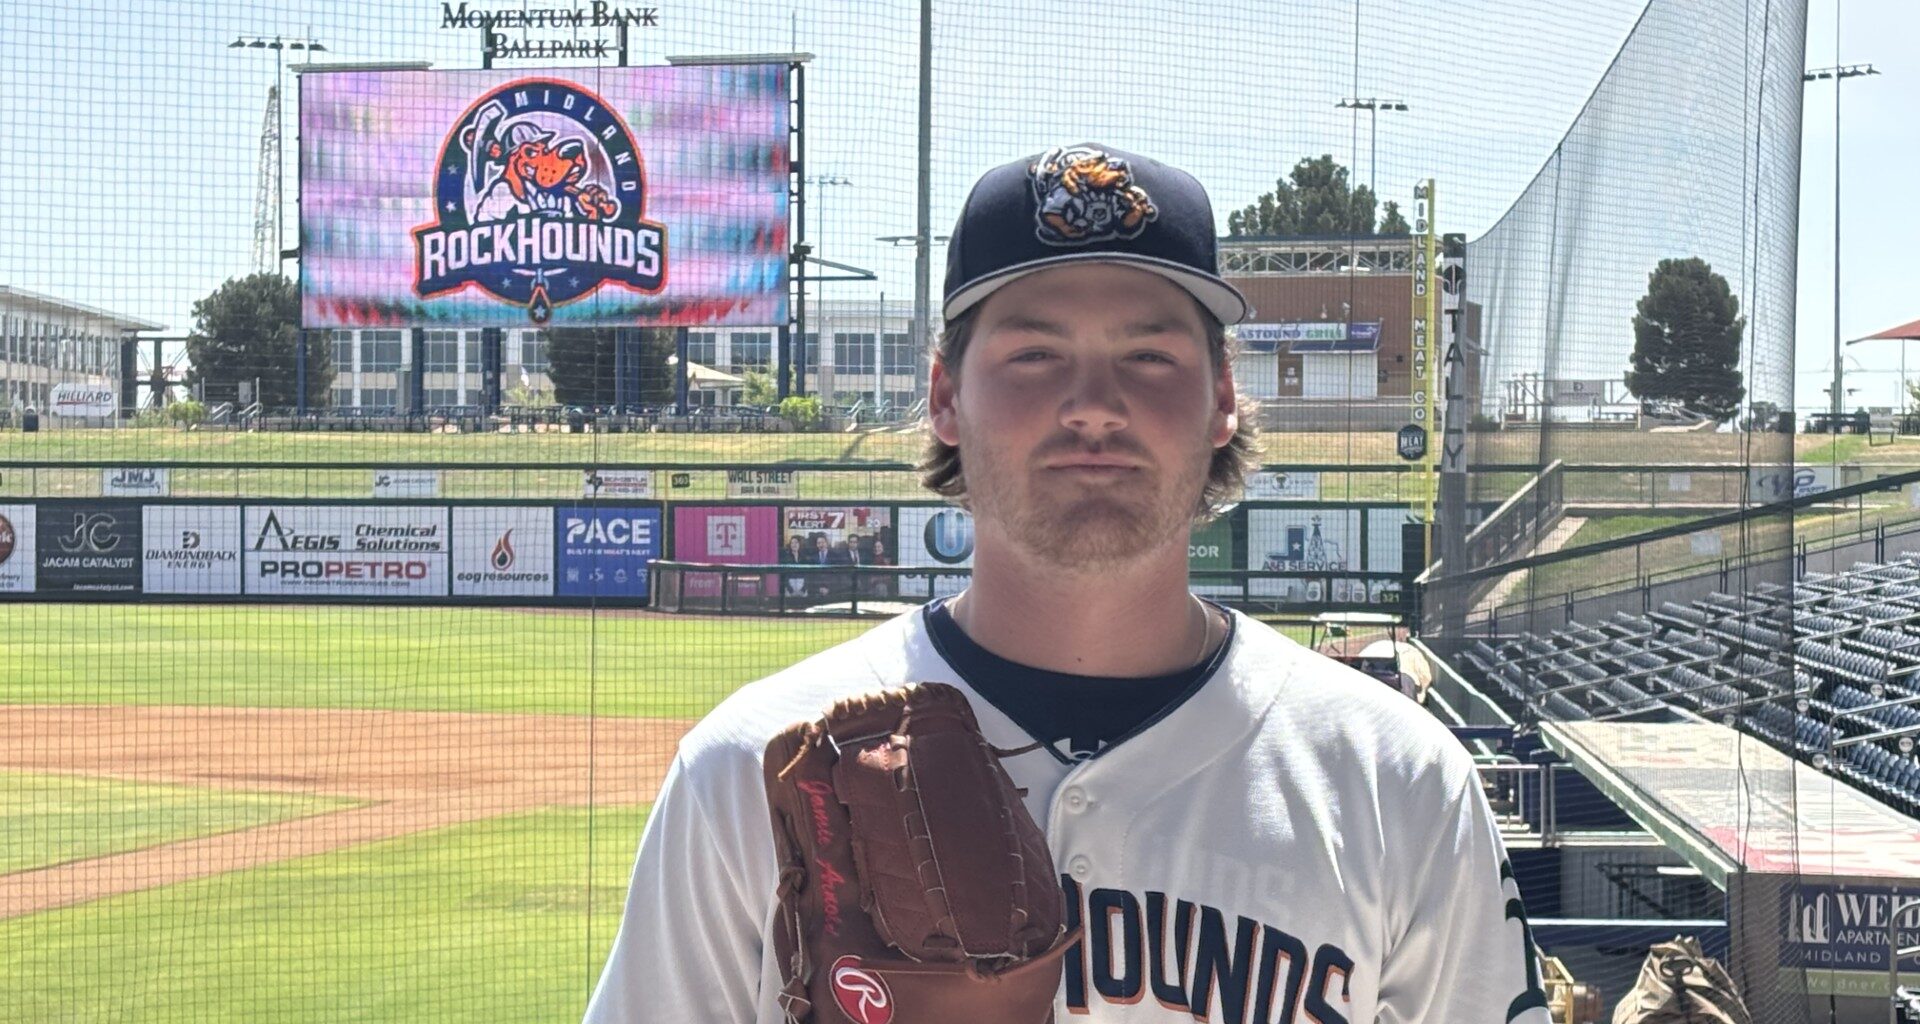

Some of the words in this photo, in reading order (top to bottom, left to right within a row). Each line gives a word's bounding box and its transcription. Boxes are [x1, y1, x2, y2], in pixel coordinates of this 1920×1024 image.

[592, 2, 658, 27] BANK
[489, 34, 609, 59] BALLPARK
[515, 91, 637, 193] MIDLAND
[422, 219, 662, 281] ROCKHOUNDS
[1413, 186, 1428, 296] MIDLAND
[1413, 319, 1427, 380] MEAT
[1413, 391, 1427, 421] CO
[729, 470, 754, 484] WALL
[757, 470, 793, 484] STREET
[789, 512, 826, 520] FIRST
[790, 520, 826, 529] ALERT
[828, 511, 844, 529] 7
[355, 524, 436, 537] Chemical
[566, 518, 650, 544] PACE
[356, 538, 441, 551] Solutions
[42, 558, 80, 568] JACAM
[83, 558, 134, 568] CATALYST
[167, 561, 212, 569] ENERGY
[260, 561, 427, 580] PROPETRO
[1289, 561, 1347, 571] SERVICE
[457, 572, 481, 581] eog
[483, 571, 549, 582] resources
